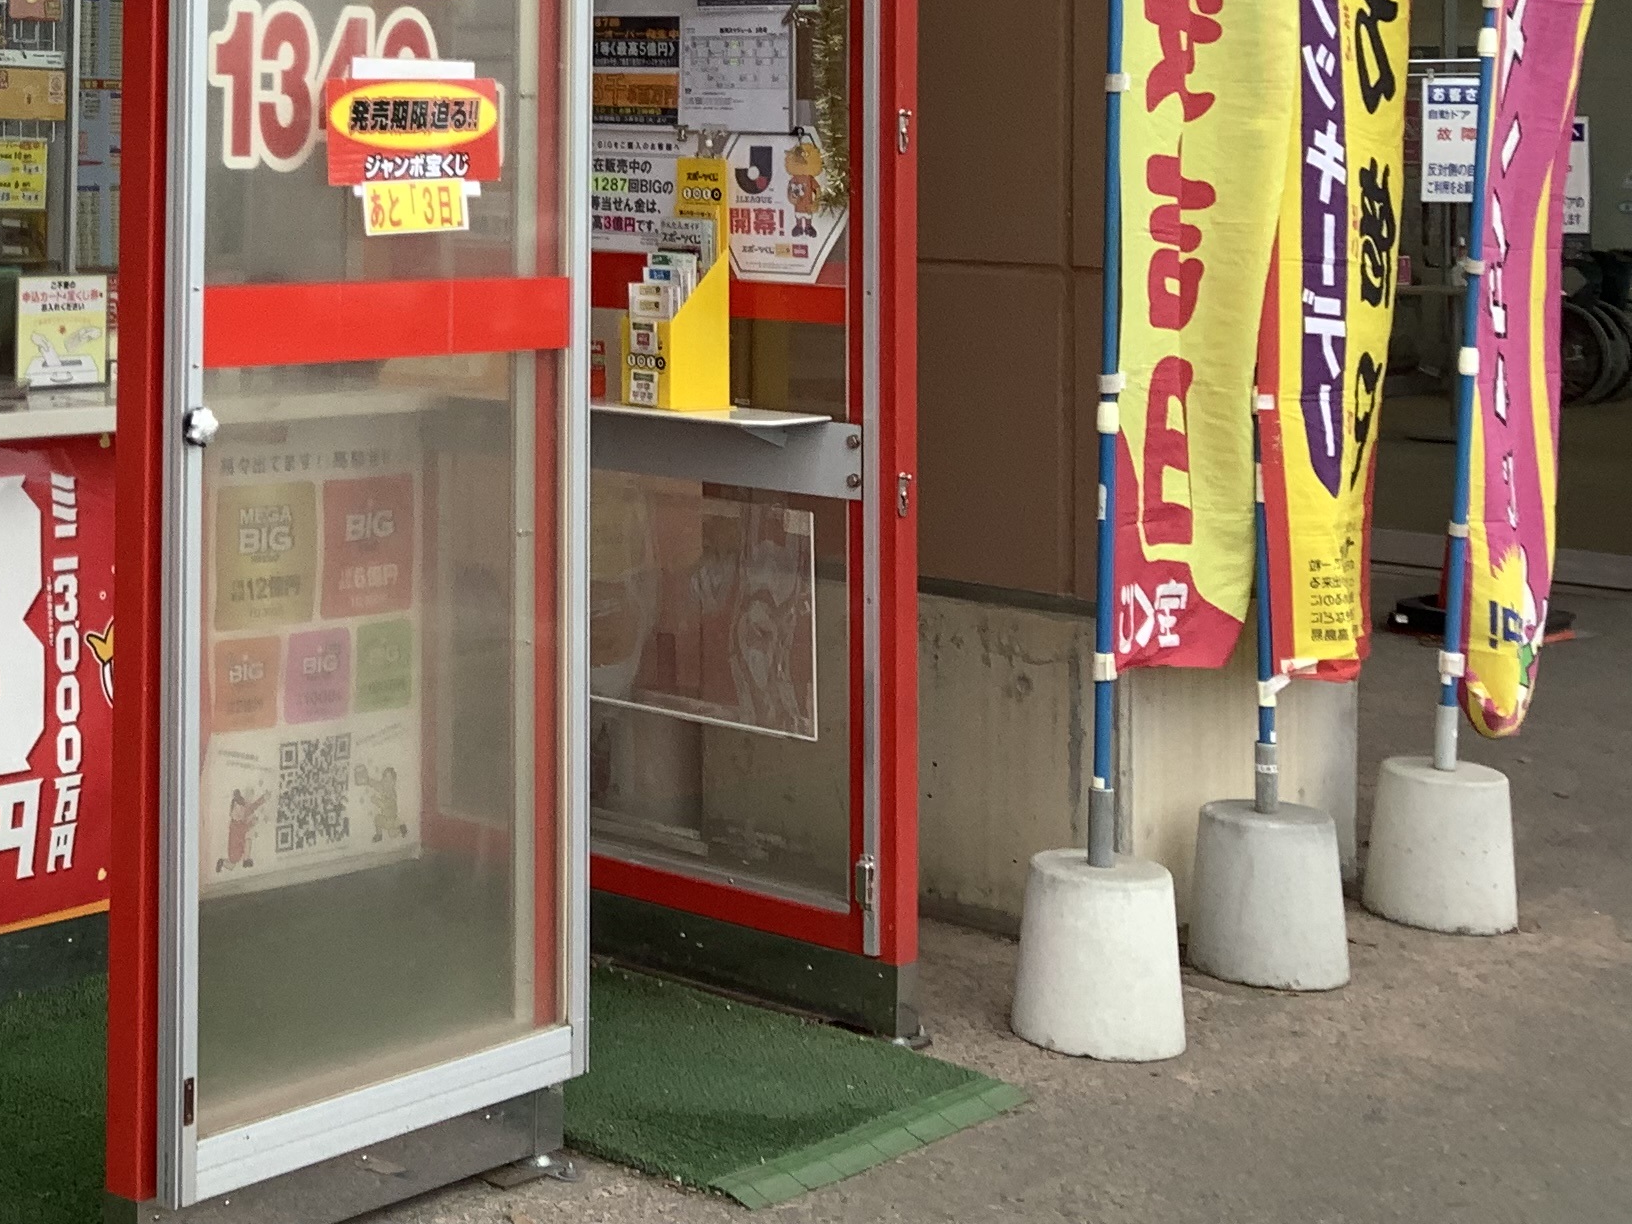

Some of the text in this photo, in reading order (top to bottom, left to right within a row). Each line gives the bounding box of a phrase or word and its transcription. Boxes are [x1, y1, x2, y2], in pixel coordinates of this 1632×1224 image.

[364, 154, 470, 179] ジャンボ宝くじ
[729, 207, 785, 237] 開幕!
[238, 526, 294, 554] BIG
[346, 509, 396, 543] BIG
